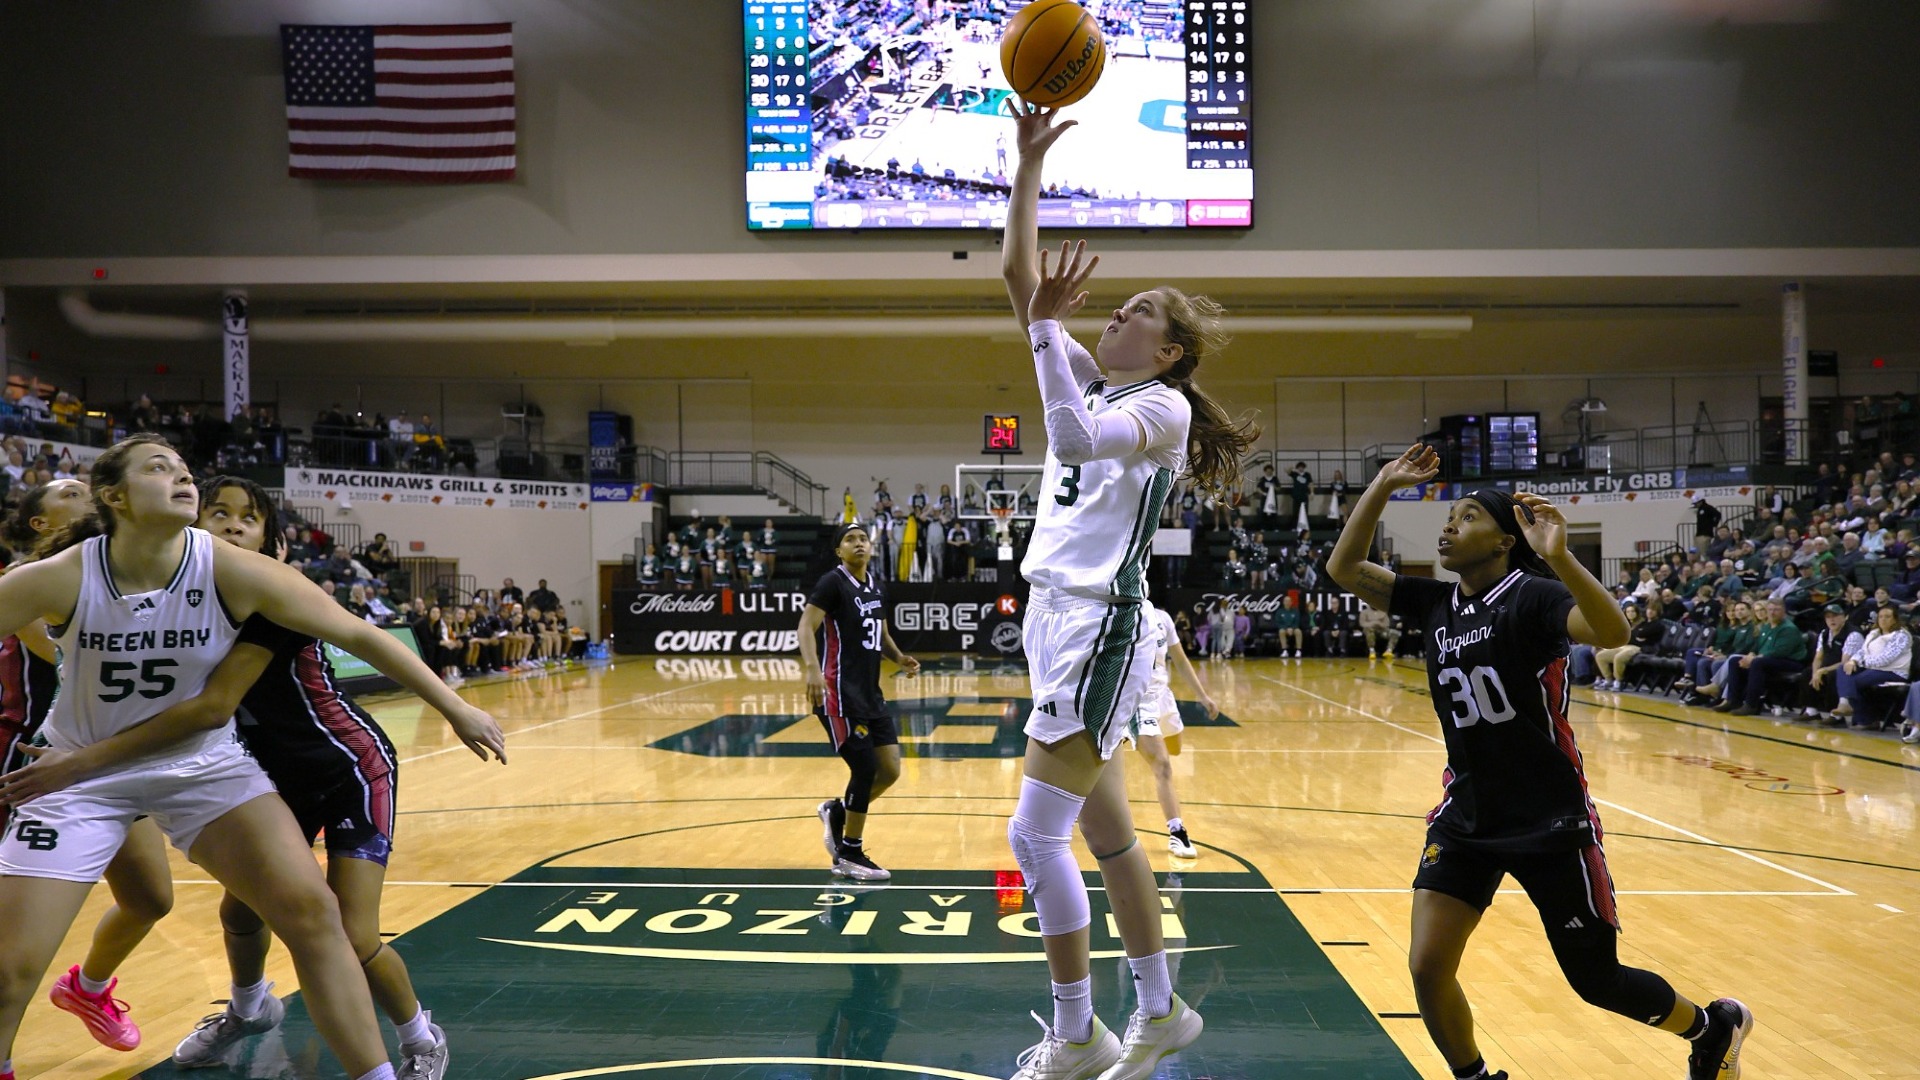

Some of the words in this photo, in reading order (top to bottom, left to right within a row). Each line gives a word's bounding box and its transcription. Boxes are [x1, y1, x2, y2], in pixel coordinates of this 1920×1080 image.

[756, 17, 764, 30] 1
[796, 17, 804, 30] 1
[1216, 12, 1226, 25] 2
[1234, 12, 1245, 25] 0
[755, 36, 765, 50] 3
[794, 36, 805, 49] 0
[1190, 31, 1207, 45] 11
[1235, 32, 1245, 44] 3
[750, 54, 769, 68] 20
[794, 54, 805, 67] 0
[1043, 34, 1097, 94] Wilson
[1190, 51, 1208, 64] 14
[1213, 51, 1230, 64] 17
[1234, 51, 1245, 63] 0
[751, 74, 769, 87] 30
[774, 75, 790, 87] 17
[795, 75, 806, 87] 0
[1189, 70, 1208, 84] 30
[1216, 71, 1227, 83] 5
[1235, 71, 1245, 83] 3
[751, 93, 770, 107] 55
[774, 94, 791, 107] 10
[796, 94, 806, 107] 2
[1190, 89, 1208, 102] 31
[1237, 89, 1245, 102] 1
[230, 339, 245, 419] MACKINA
[990, 428, 1015, 448] 24
[317, 472, 433, 490] MACKINAWS
[439, 479, 487, 493] GRILL
[493, 482, 504, 494] &
[510, 483, 568, 497] SPIRITS
[1054, 463, 1081, 507] 3
[1515, 478, 1588, 494] Phoenix
[1594, 476, 1623, 492] Fly
[1628, 471, 1673, 489] GRB
[629, 592, 718, 615] Michelob
[739, 592, 807, 613] ULTR
[163, 628, 210, 648] BAY
[655, 630, 738, 652] COURT
[740, 630, 801, 651] CLUB
[861, 617, 882, 652] 31
[97, 658, 179, 703] 55
[1437, 665, 1517, 729] 30
[15, 820, 59, 851] GB
